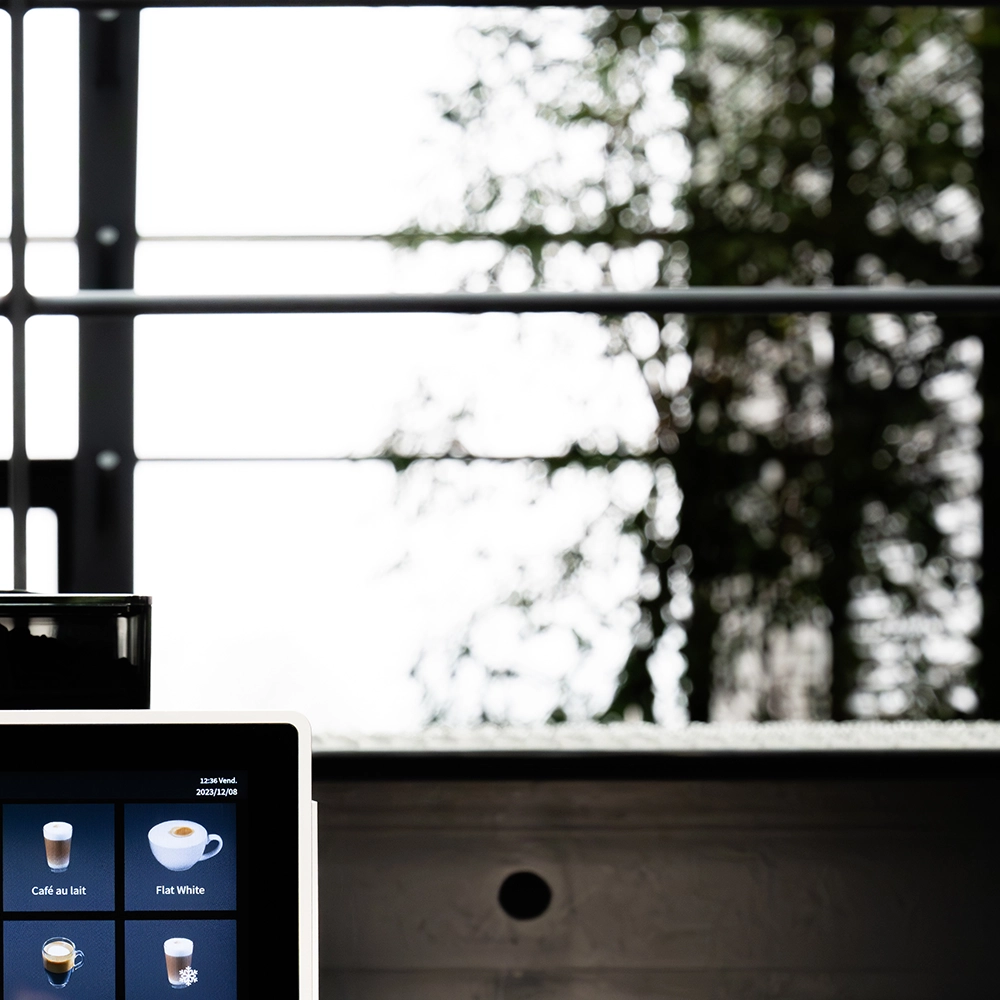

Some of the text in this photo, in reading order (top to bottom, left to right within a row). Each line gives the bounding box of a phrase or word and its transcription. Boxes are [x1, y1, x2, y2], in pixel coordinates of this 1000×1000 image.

[218, 776, 238, 784] Vend.
[196, 788, 238, 797] 2023/12/08
[31, 884, 87, 896] Café au lait
[156, 884, 206, 895] Flat White
